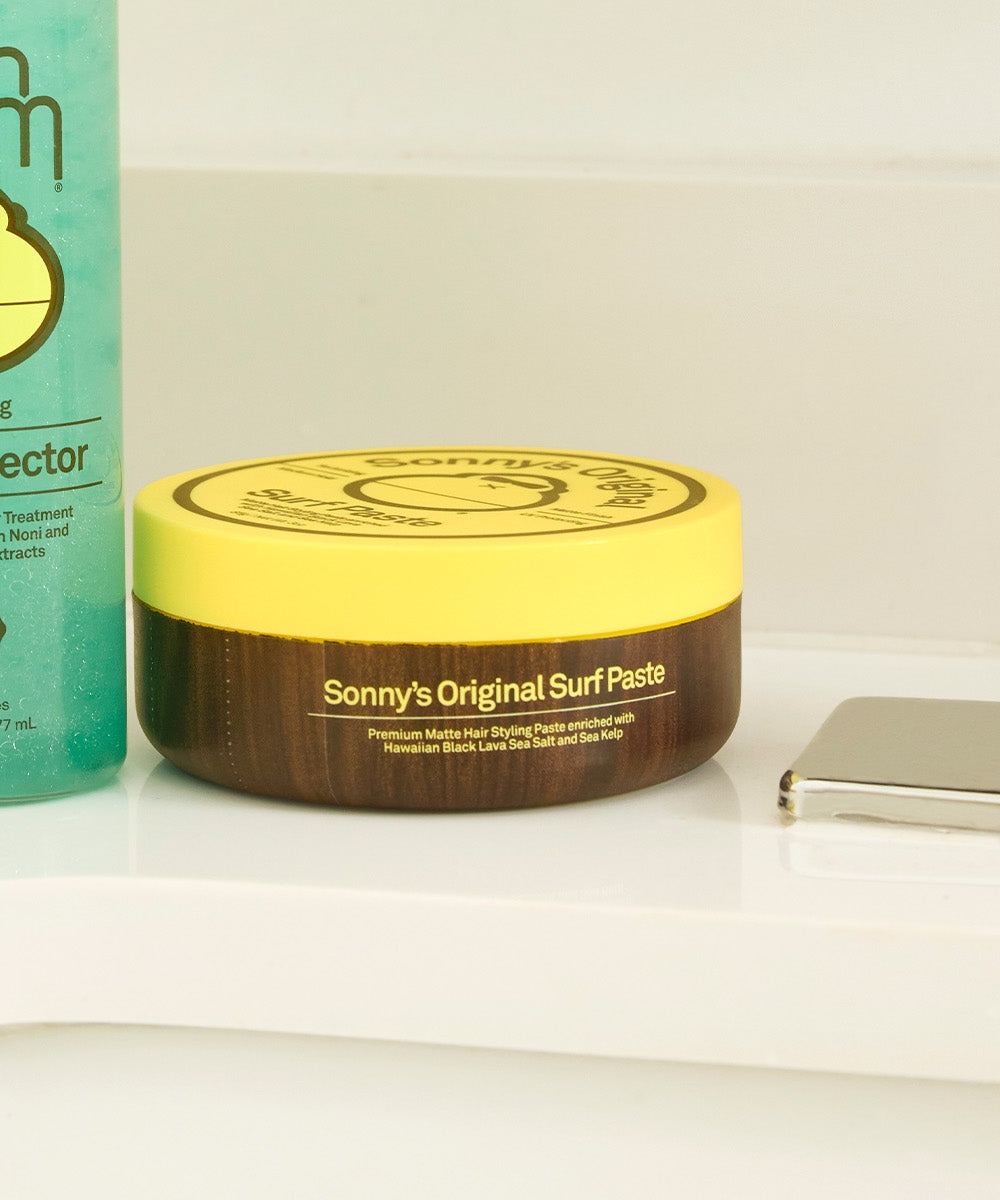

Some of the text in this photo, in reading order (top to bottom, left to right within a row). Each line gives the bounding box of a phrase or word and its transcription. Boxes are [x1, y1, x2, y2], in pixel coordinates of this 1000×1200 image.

[579, 467, 667, 509] Original
[3, 506, 73, 524] Treatment
[247, 488, 347, 512] Surf
[327, 505, 442, 527] Paste
[10, 529, 41, 541] Noni
[46, 523, 68, 538] and
[438, 675, 546, 712] Original
[550, 668, 603, 699] Surf
[608, 662, 665, 692] Paste
[16, 717, 36, 730] mL
[369, 712, 634, 740] Premium Matte Hair Styling Paste enriched with
[384, 727, 624, 753] Hawaiian Black Lava Sea Salt and Sea Kelp
